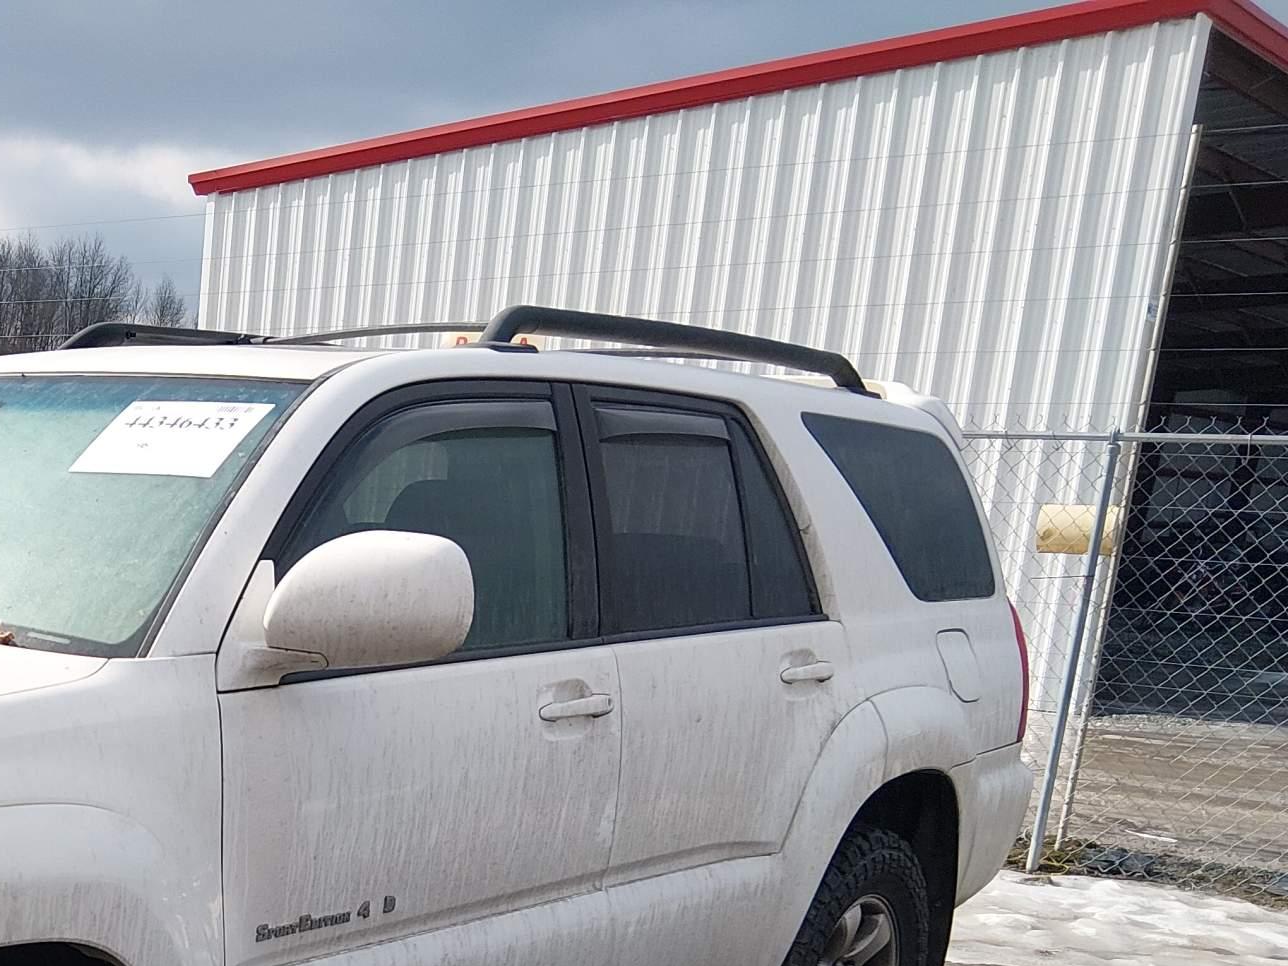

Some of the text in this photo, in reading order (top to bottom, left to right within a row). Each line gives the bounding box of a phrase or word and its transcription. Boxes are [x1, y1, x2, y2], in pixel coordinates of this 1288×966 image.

[124, 415, 240, 431] 44346433
[357, 900, 371, 919] 4
[382, 895, 396, 914] D
